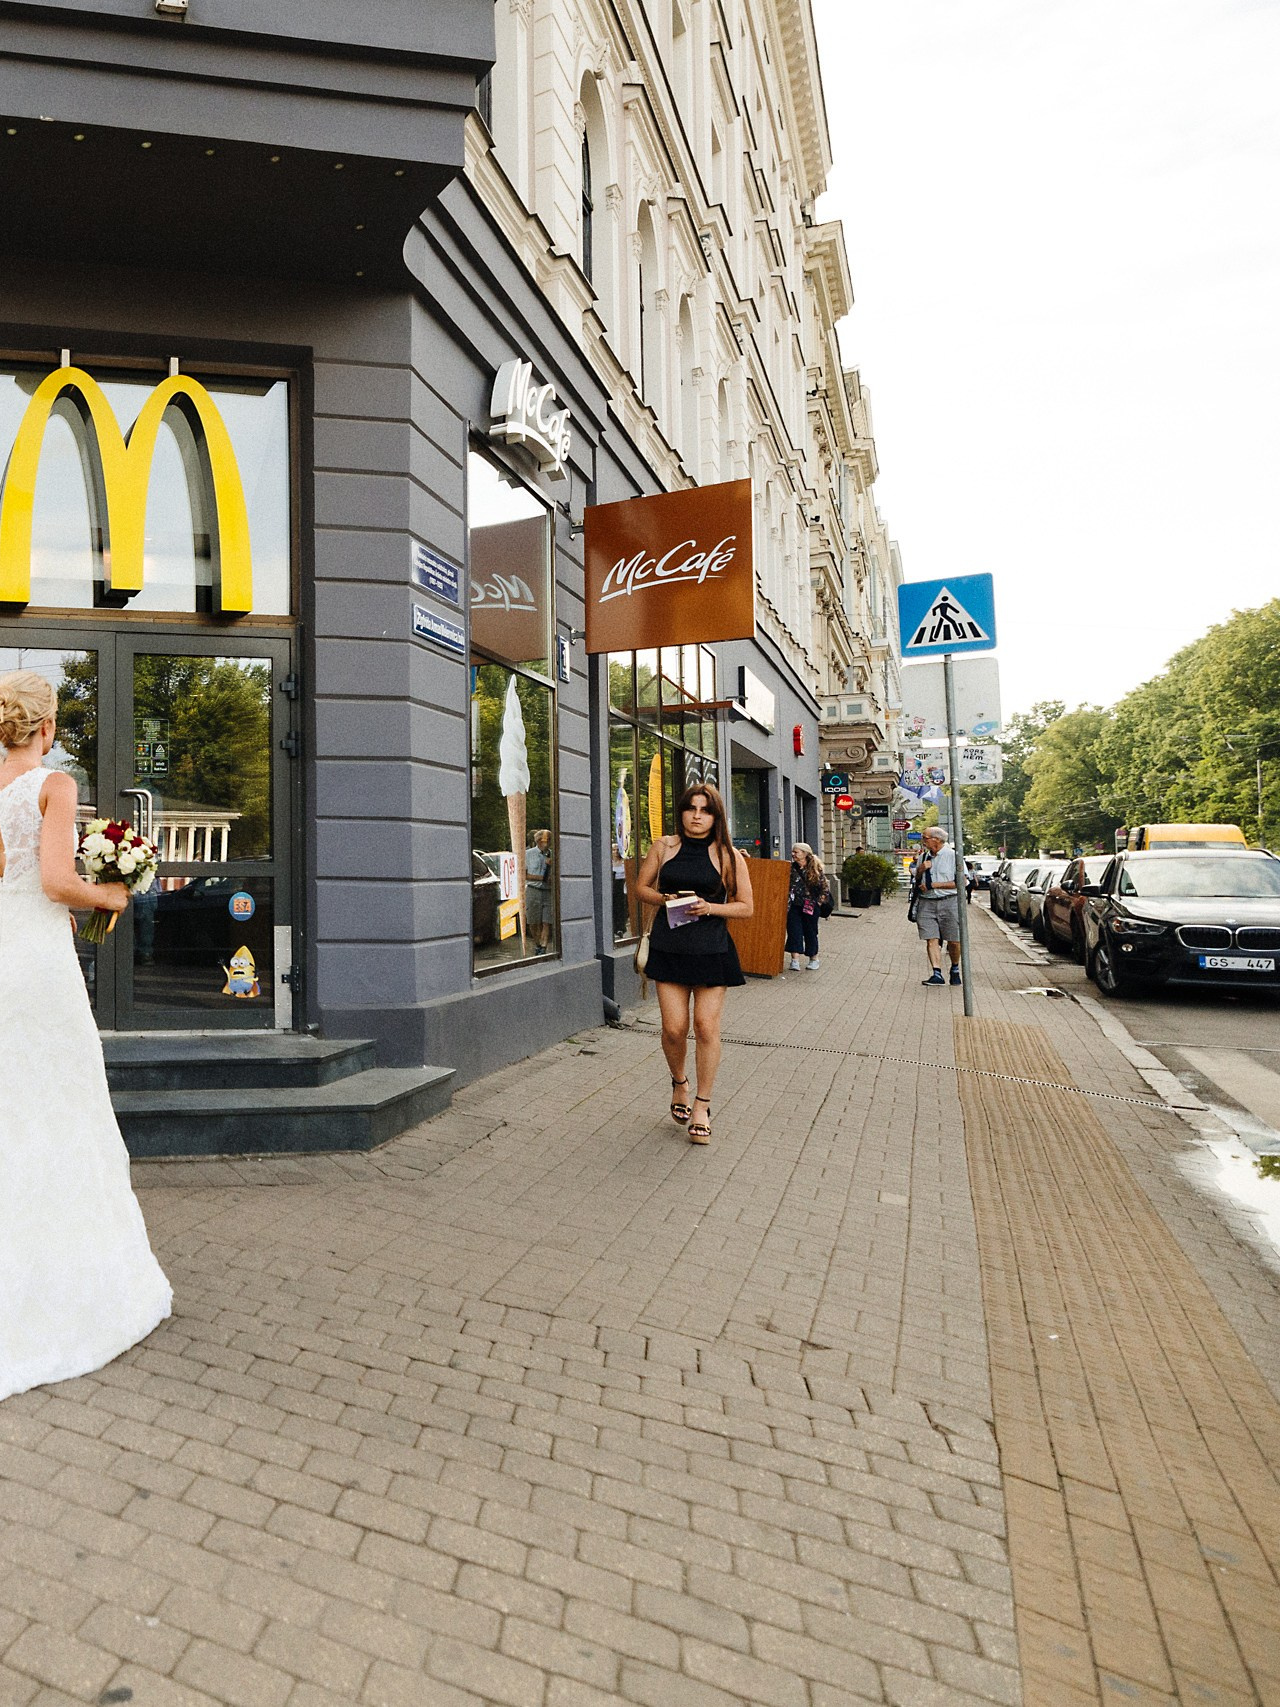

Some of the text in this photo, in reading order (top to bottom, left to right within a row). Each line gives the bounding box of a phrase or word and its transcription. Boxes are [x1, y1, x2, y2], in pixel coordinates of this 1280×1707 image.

[505, 358, 571, 472] McCafé
[600, 536, 737, 598] McCafé
[1247, 959, 1272, 969] 447
